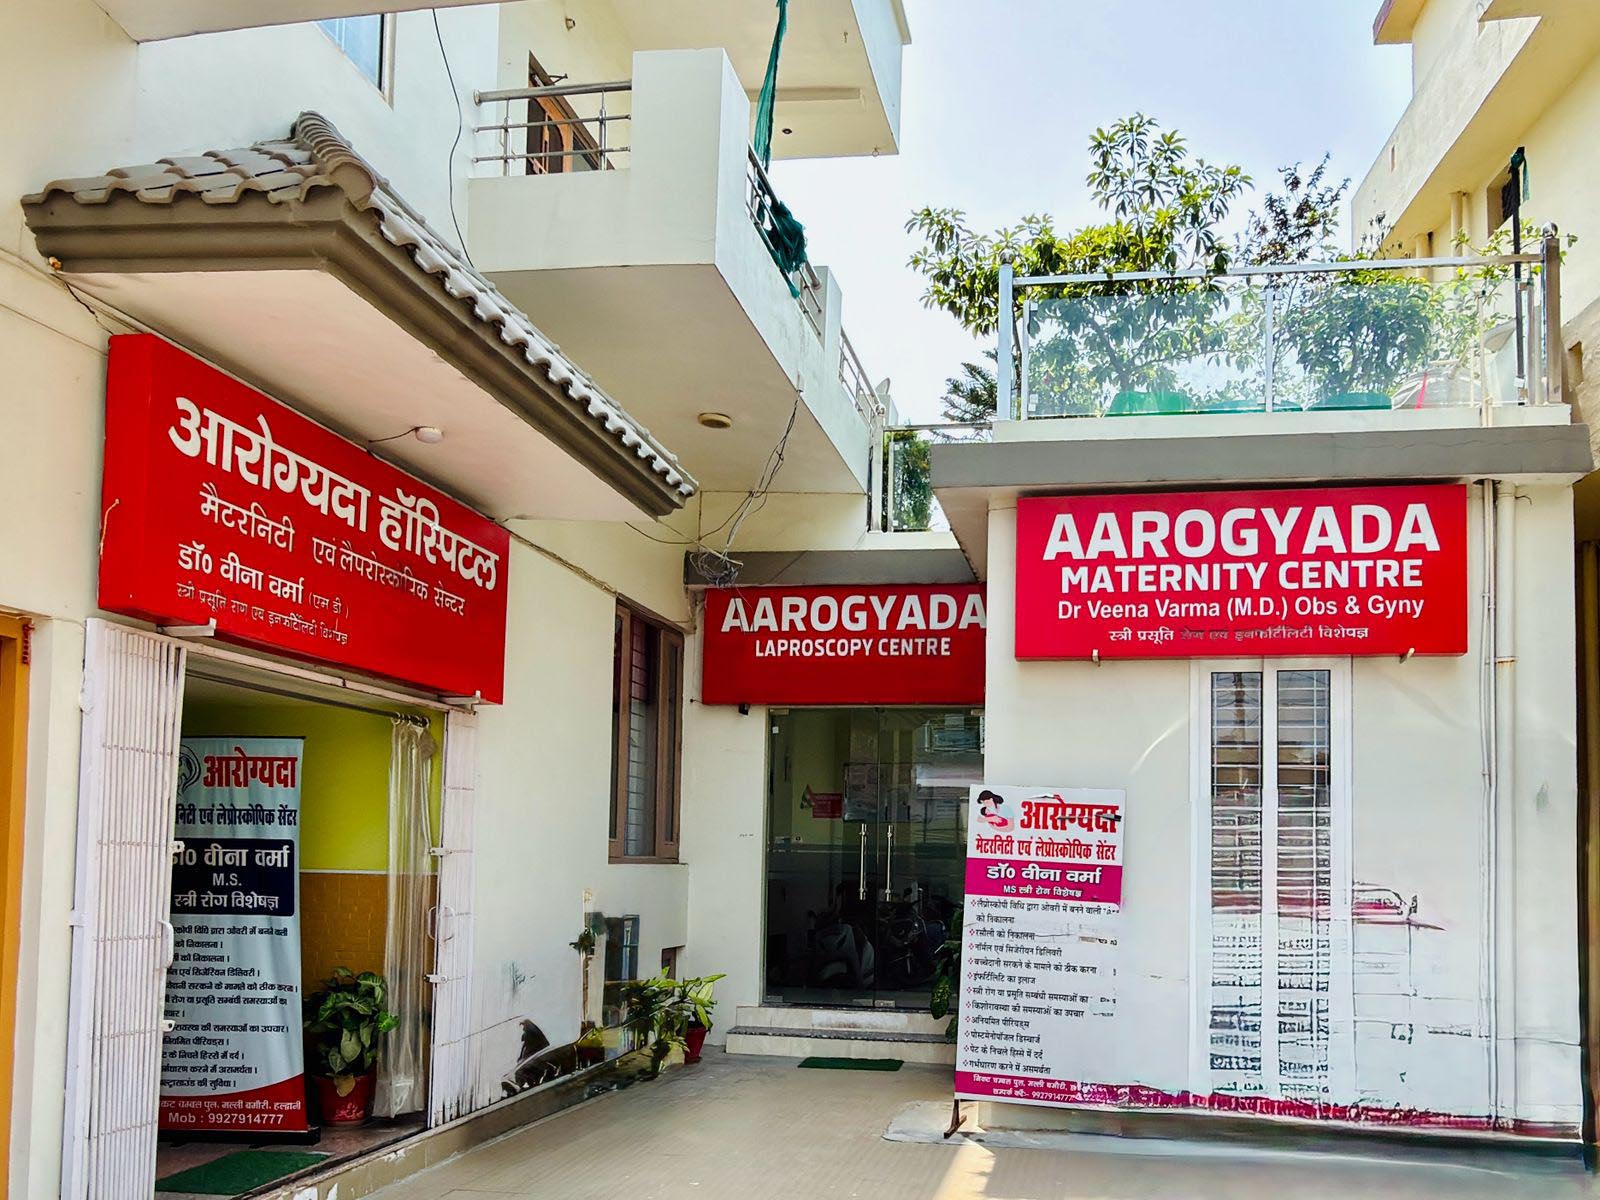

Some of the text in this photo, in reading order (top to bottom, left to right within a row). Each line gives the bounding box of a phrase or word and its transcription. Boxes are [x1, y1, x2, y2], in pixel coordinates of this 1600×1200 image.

[168, 396, 499, 590] आरोग्यदा हॉस्पिटल
[199, 482, 295, 552] मैटरनिटी
[312, 537, 336, 566] एवं
[1043, 503, 1440, 560] AAROGYADA
[220, 552, 264, 591] वीना
[268, 575, 305, 604] वर्मा
[1061, 559, 1423, 594] MATERNITY CENTRE
[721, 593, 987, 633] AAROGYADA
[1058, 594, 1424, 621] Dr Veena Varma (M.D.) Obs & Gyny
[755, 637, 952, 657] LAPROSCOPY CENTRE
[1109, 626, 1132, 642] स्त्री
[1137, 626, 1174, 645] प्रसूति
[203, 746, 298, 788] आरोग्यदा
[199, 803, 215, 825] एवं
[278, 804, 297, 826] सेंटर
[204, 843, 290, 868] वीना वर्मा
[975, 834, 1117, 861] मेटरनिटी एवं लेप्रोस्कोपिक सेंटर
[212, 873, 242, 886] M.S.
[1021, 863, 1103, 884] वीना वर्मा
[174, 890, 279, 911] स्त्री रोग विशेषज्ञ
[168, 1112, 197, 1123] Mob
[208, 1113, 284, 1124] 9927914777
